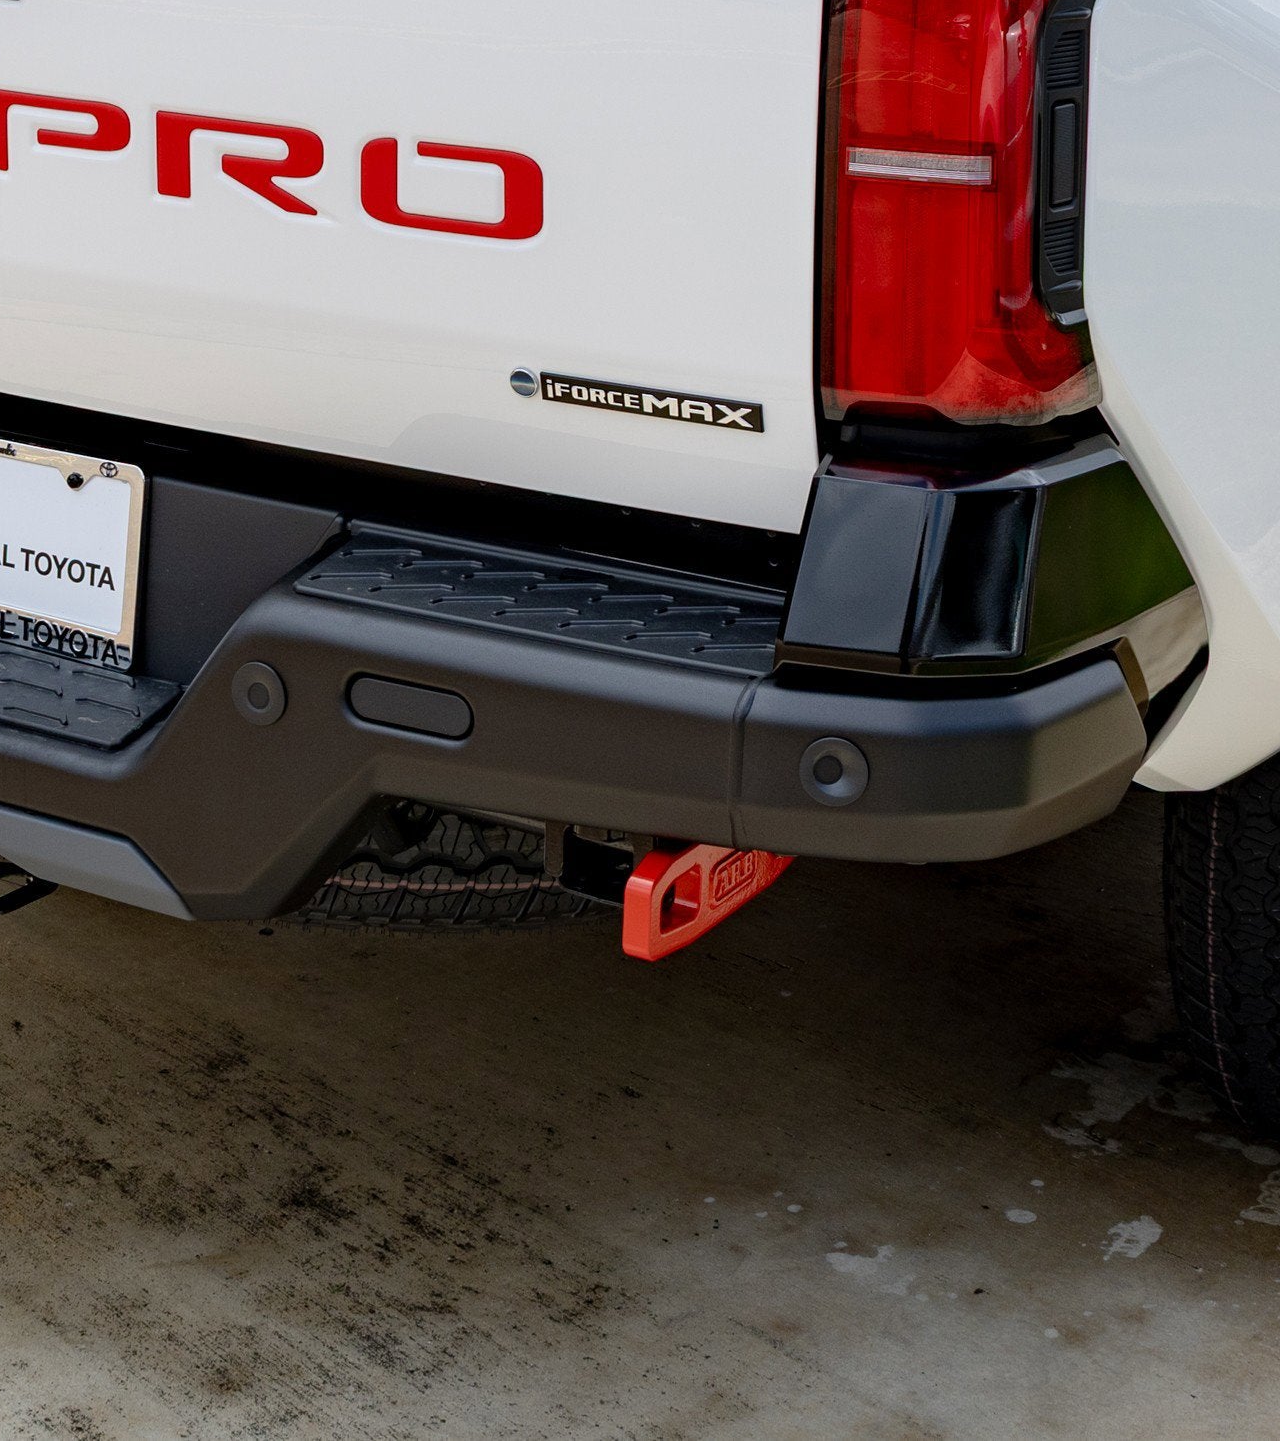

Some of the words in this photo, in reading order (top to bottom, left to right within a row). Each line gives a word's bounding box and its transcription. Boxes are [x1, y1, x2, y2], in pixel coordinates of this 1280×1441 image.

[20, 547, 116, 592] TOYOTA
[18, 614, 120, 666] TOYOTA
[717, 850, 755, 898] ARB
